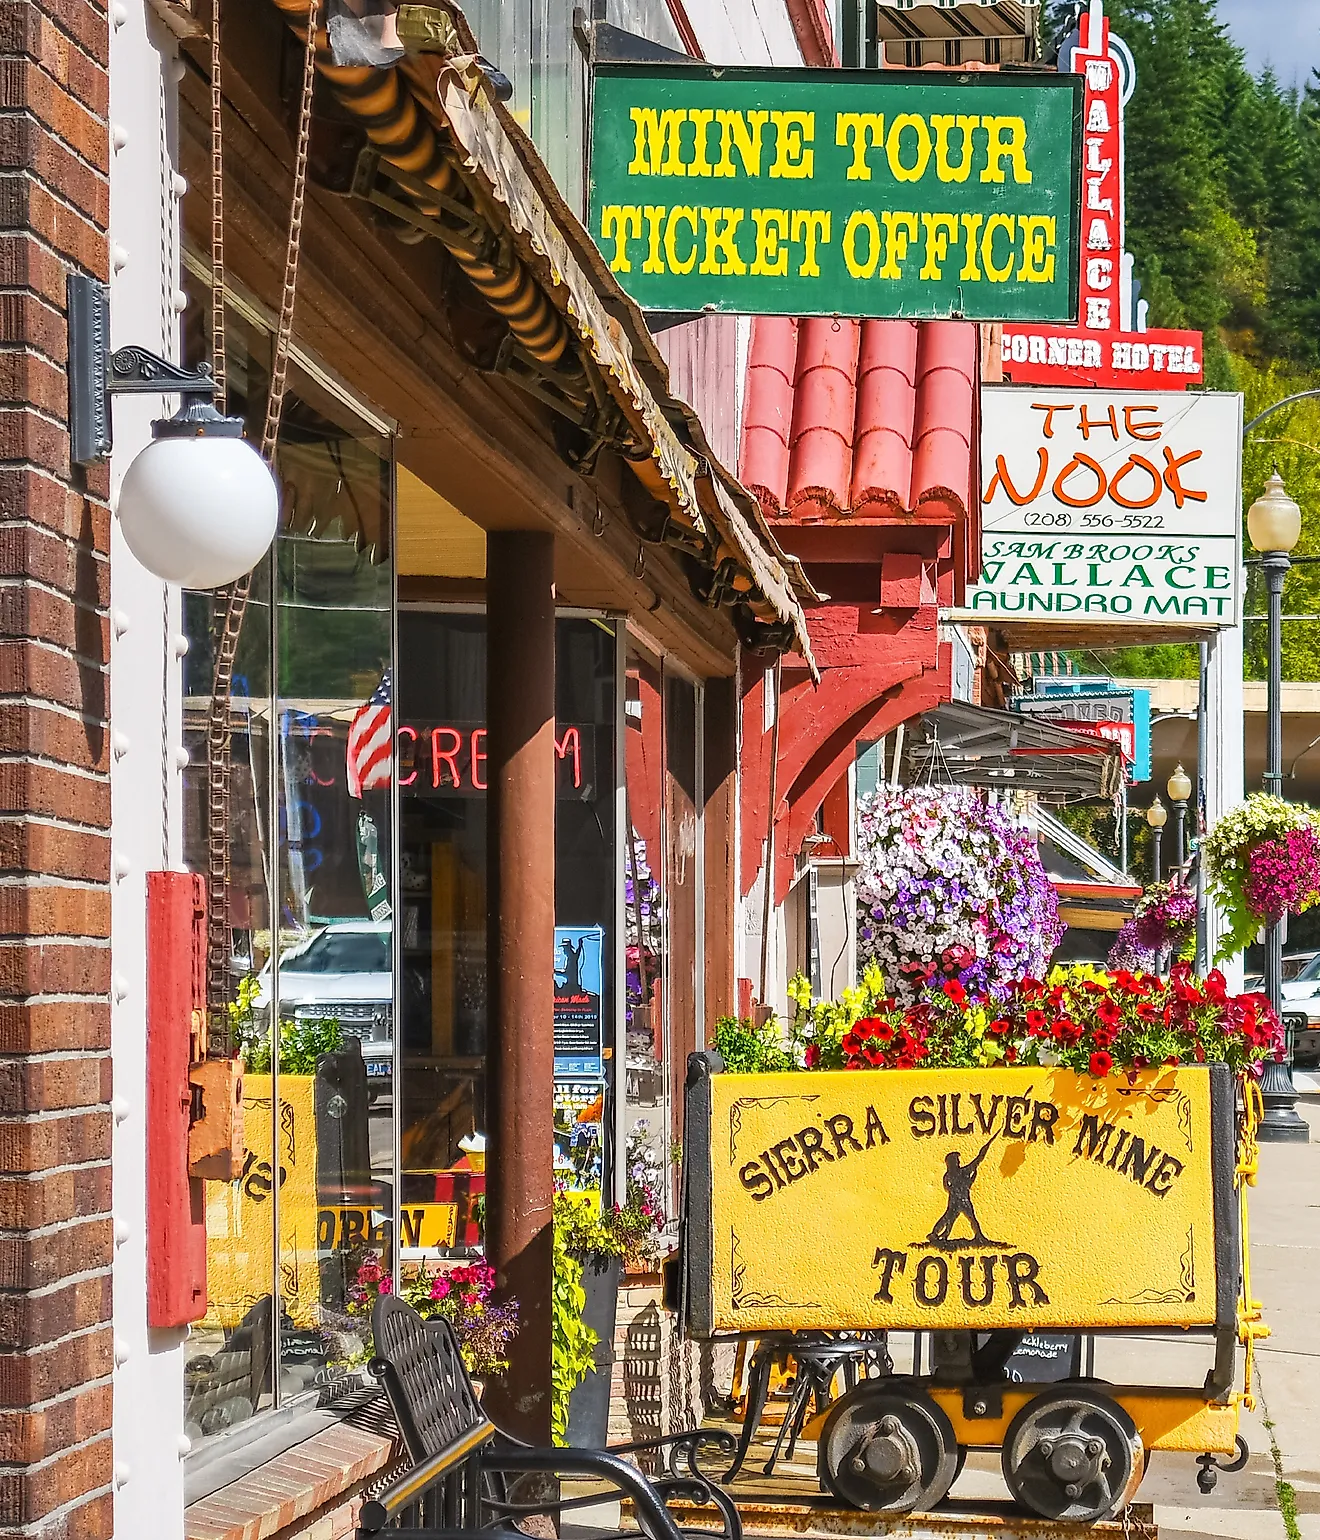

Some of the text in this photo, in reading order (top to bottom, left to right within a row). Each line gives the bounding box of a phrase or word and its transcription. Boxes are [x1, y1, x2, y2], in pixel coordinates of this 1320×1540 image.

[627, 106, 1033, 185] MINE TOUR
[1084, 59, 1114, 331] WALLACE
[600, 204, 1059, 285] TICKET OFFICE
[1000, 333, 1201, 375] CORNER HOTEL
[1030, 402, 1165, 442] THE
[982, 445, 1208, 510] NOOK
[1023, 512, 1166, 529] (208) 556-5522
[983, 540, 1201, 564] SAM BROOKS
[966, 589, 1232, 617] AUNDRO MAT
[397, 726, 582, 790] CREM
[553, 1093, 597, 1105] story
[571, 1084, 599, 1095] for
[737, 1092, 1187, 1203] SIERRA SILVER MINE
[871, 1246, 1051, 1310] TOUR
[1021, 1335, 1069, 1353] ckleberry
